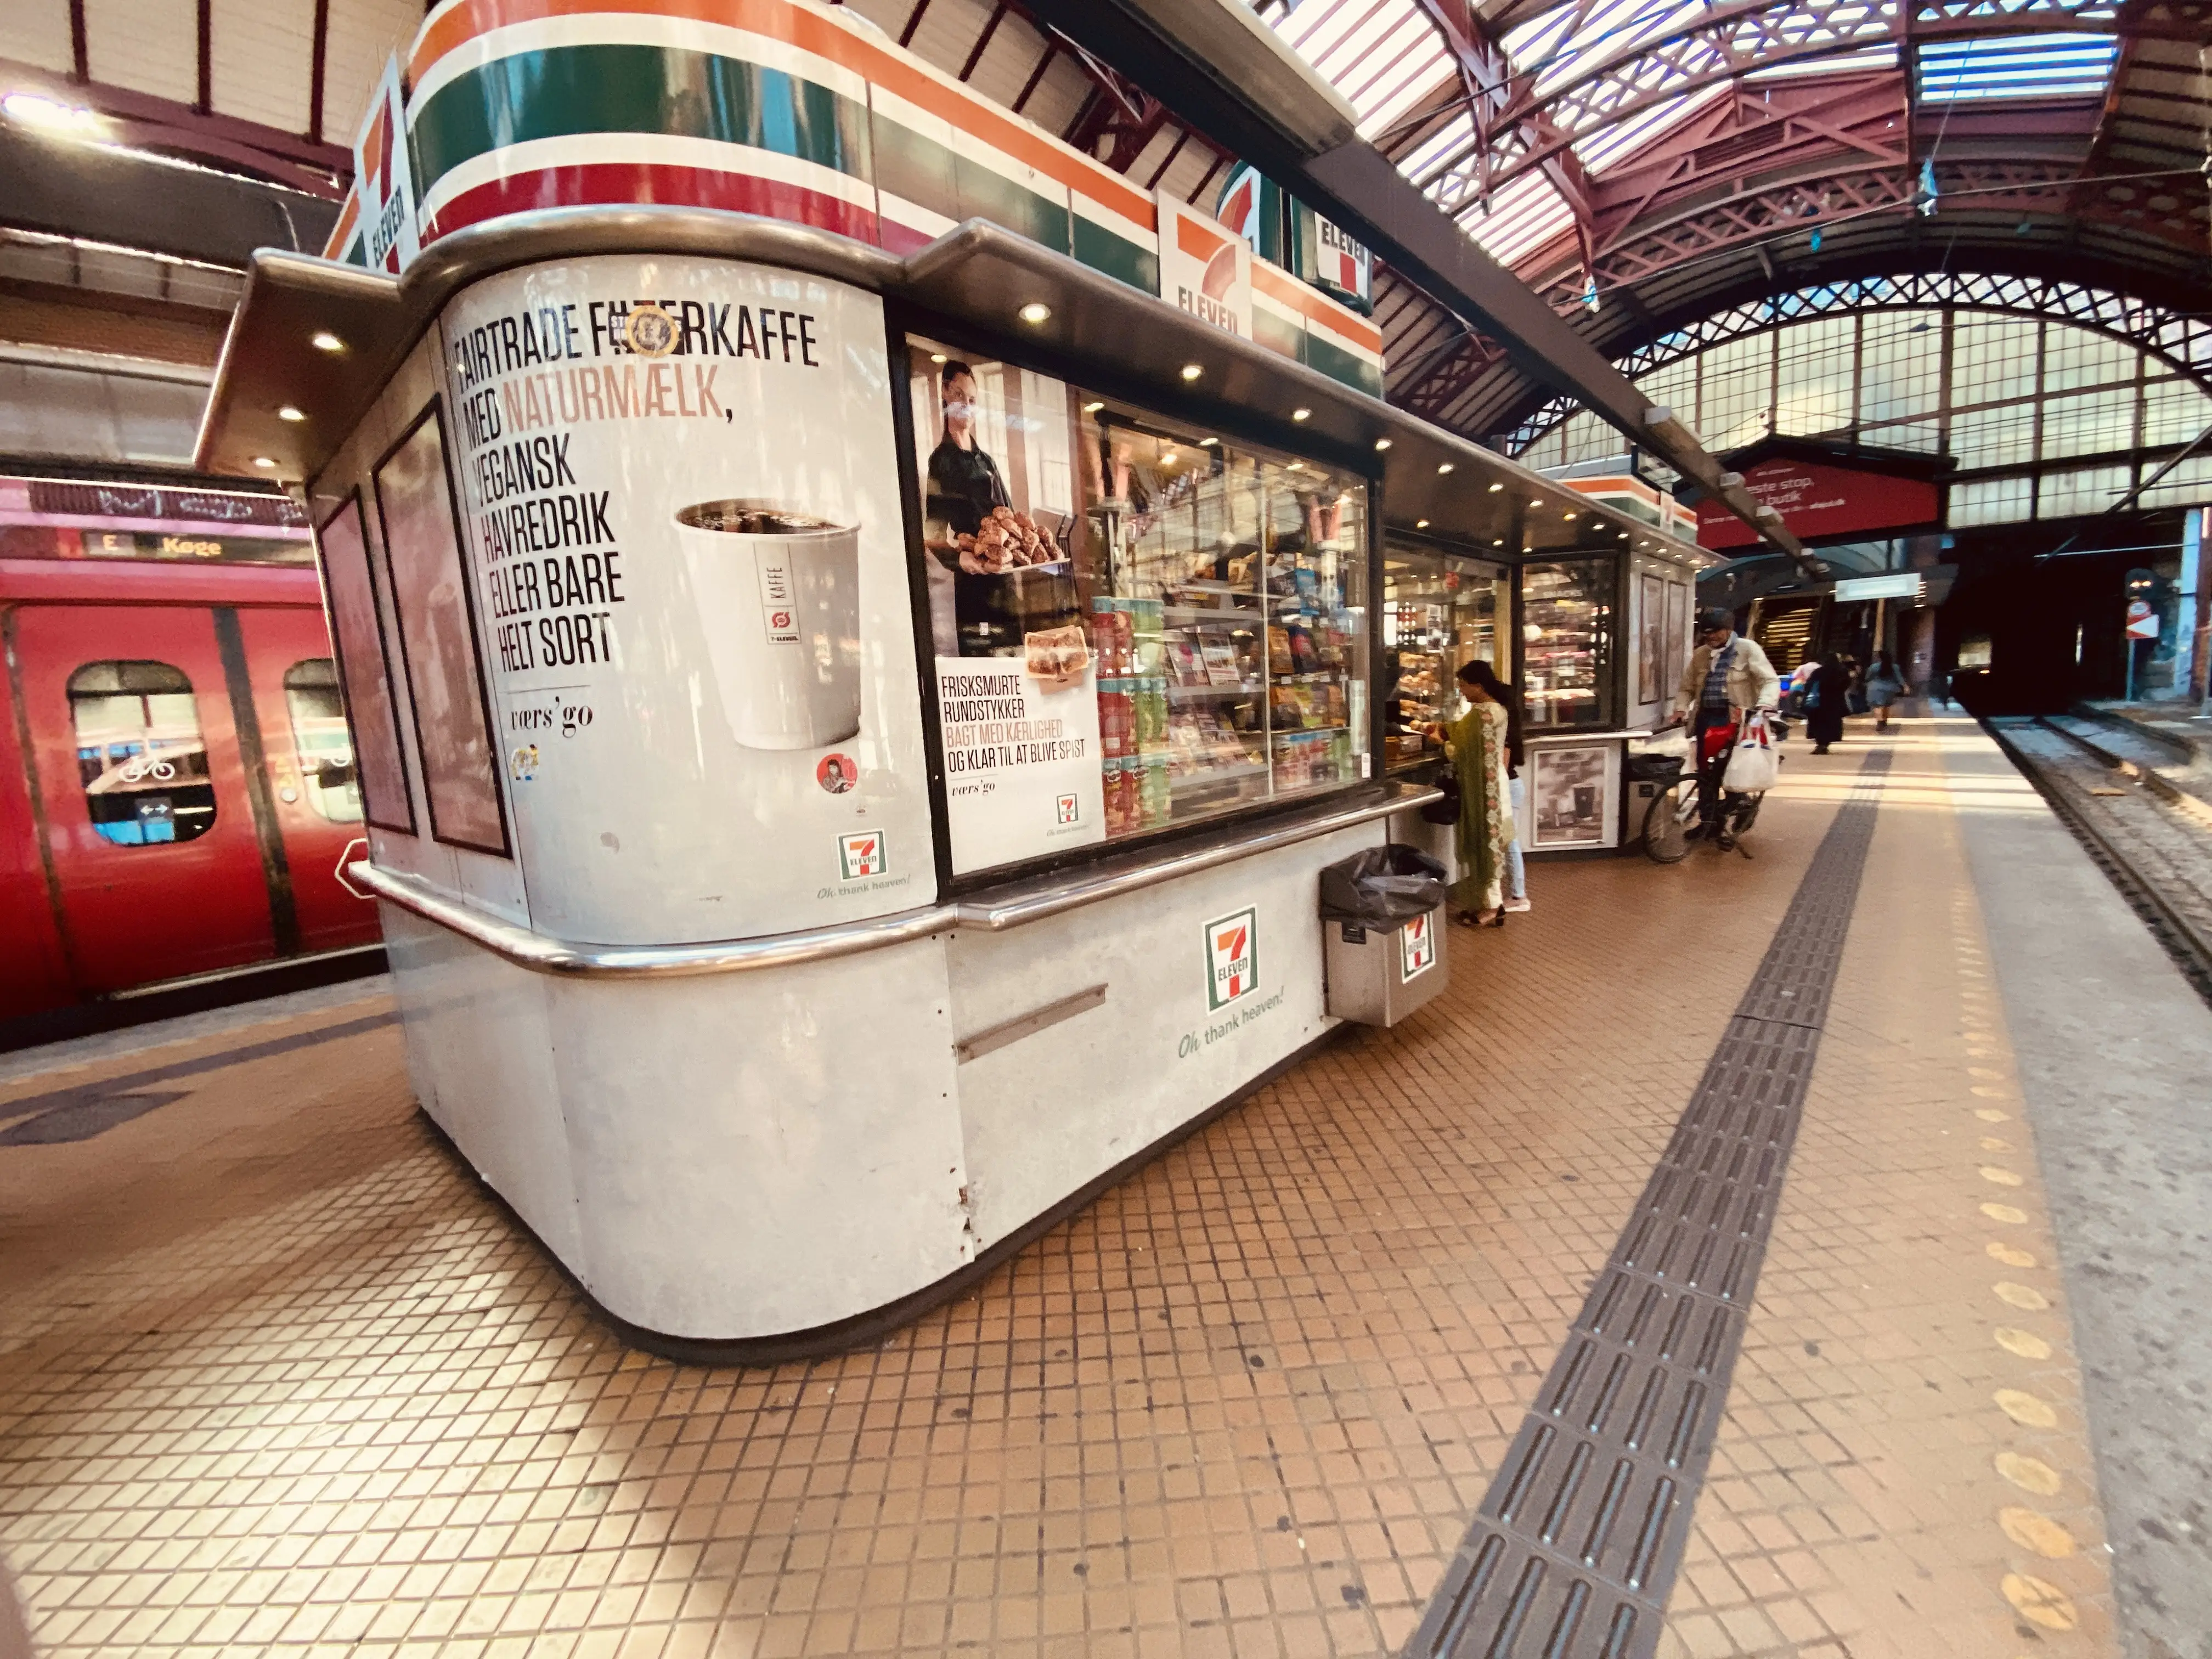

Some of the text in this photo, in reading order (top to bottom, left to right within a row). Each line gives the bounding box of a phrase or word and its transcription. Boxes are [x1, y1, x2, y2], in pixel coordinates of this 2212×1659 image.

[463, 387, 501, 452] MED
[472, 433, 576, 506] VEGANSK
[103, 534, 119, 551] E
[481, 491, 616, 563] HAVREDRIK
[490, 551, 625, 619] ELLER BARE
[766, 567, 787, 599] KAFFE
[498, 612, 611, 673] HELT SORT
[941, 675, 1021, 698] FRISKSMURTE
[944, 698, 1025, 723] RUNDSTYKKER
[946, 719, 1063, 748] BAGT MED KÆRLIGHED
[948, 738, 1085, 773] OG KLAR TIL AT BLIVE SPIST
[838, 883, 870, 896] thank
[1178, 985, 1285, 1059] Oh thank heaven!
